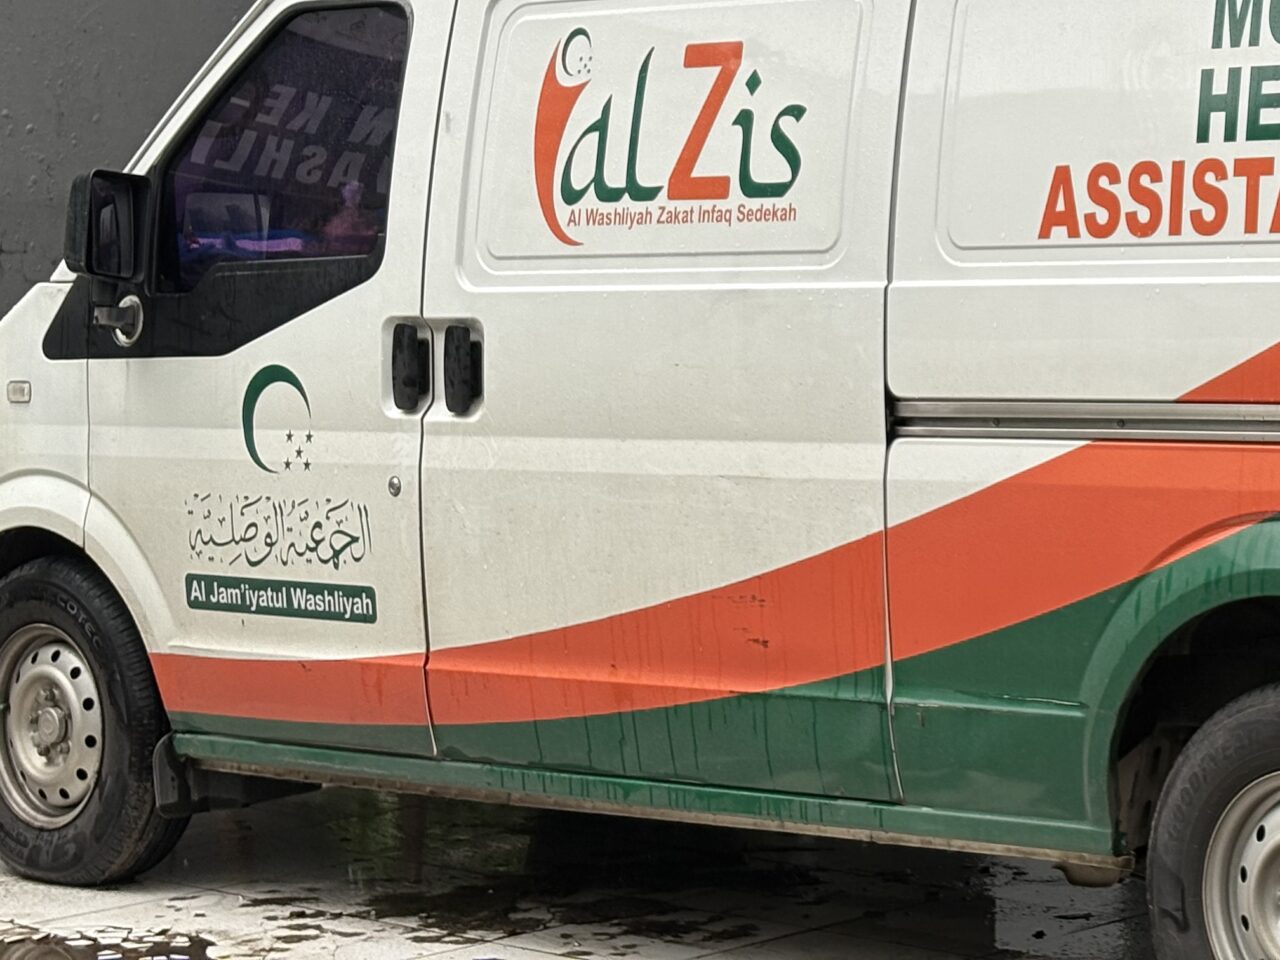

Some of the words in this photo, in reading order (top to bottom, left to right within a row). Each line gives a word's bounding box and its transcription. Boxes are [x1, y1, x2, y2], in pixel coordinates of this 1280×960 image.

[567, 209, 582, 227] Al
[585, 206, 653, 230] Washliyah
[656, 205, 695, 225] Zakat
[698, 205, 732, 227] Infaq
[736, 202, 797, 223] Sedekah
[190, 579, 206, 601] Al
[209, 582, 288, 611] Jam'iyatul
[290, 586, 373, 619] Washliyah
